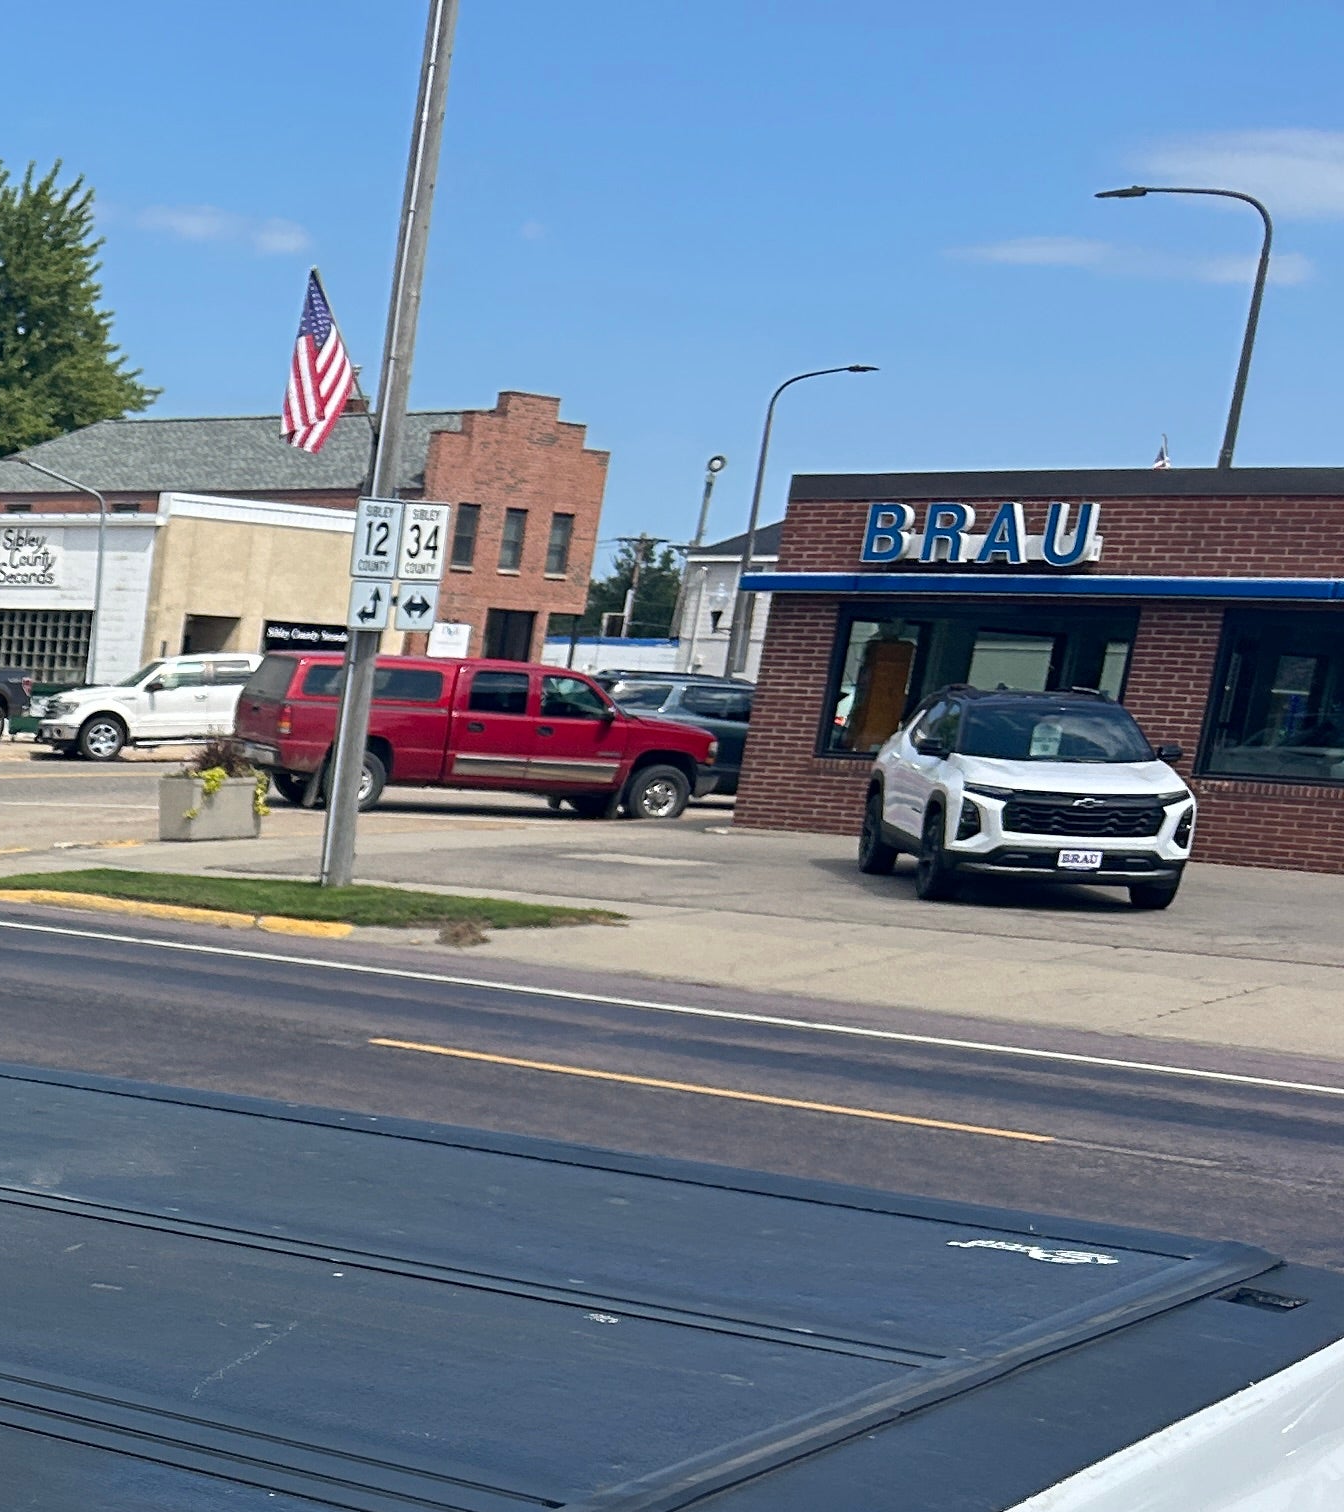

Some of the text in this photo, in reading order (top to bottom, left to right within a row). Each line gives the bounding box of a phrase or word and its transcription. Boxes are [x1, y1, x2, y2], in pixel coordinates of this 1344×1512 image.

[365, 505, 393, 518] SIBLEY
[412, 508, 440, 521] SIBLEY
[2, 527, 47, 554] Sibley
[365, 521, 389, 556] 12
[406, 524, 439, 559] 34
[861, 502, 1097, 567] BRAU
[9, 547, 57, 573] County
[358, 559, 390, 572] COUNTY
[404, 562, 436, 575] COUNTY
[1062, 853, 1099, 865] BRAU
